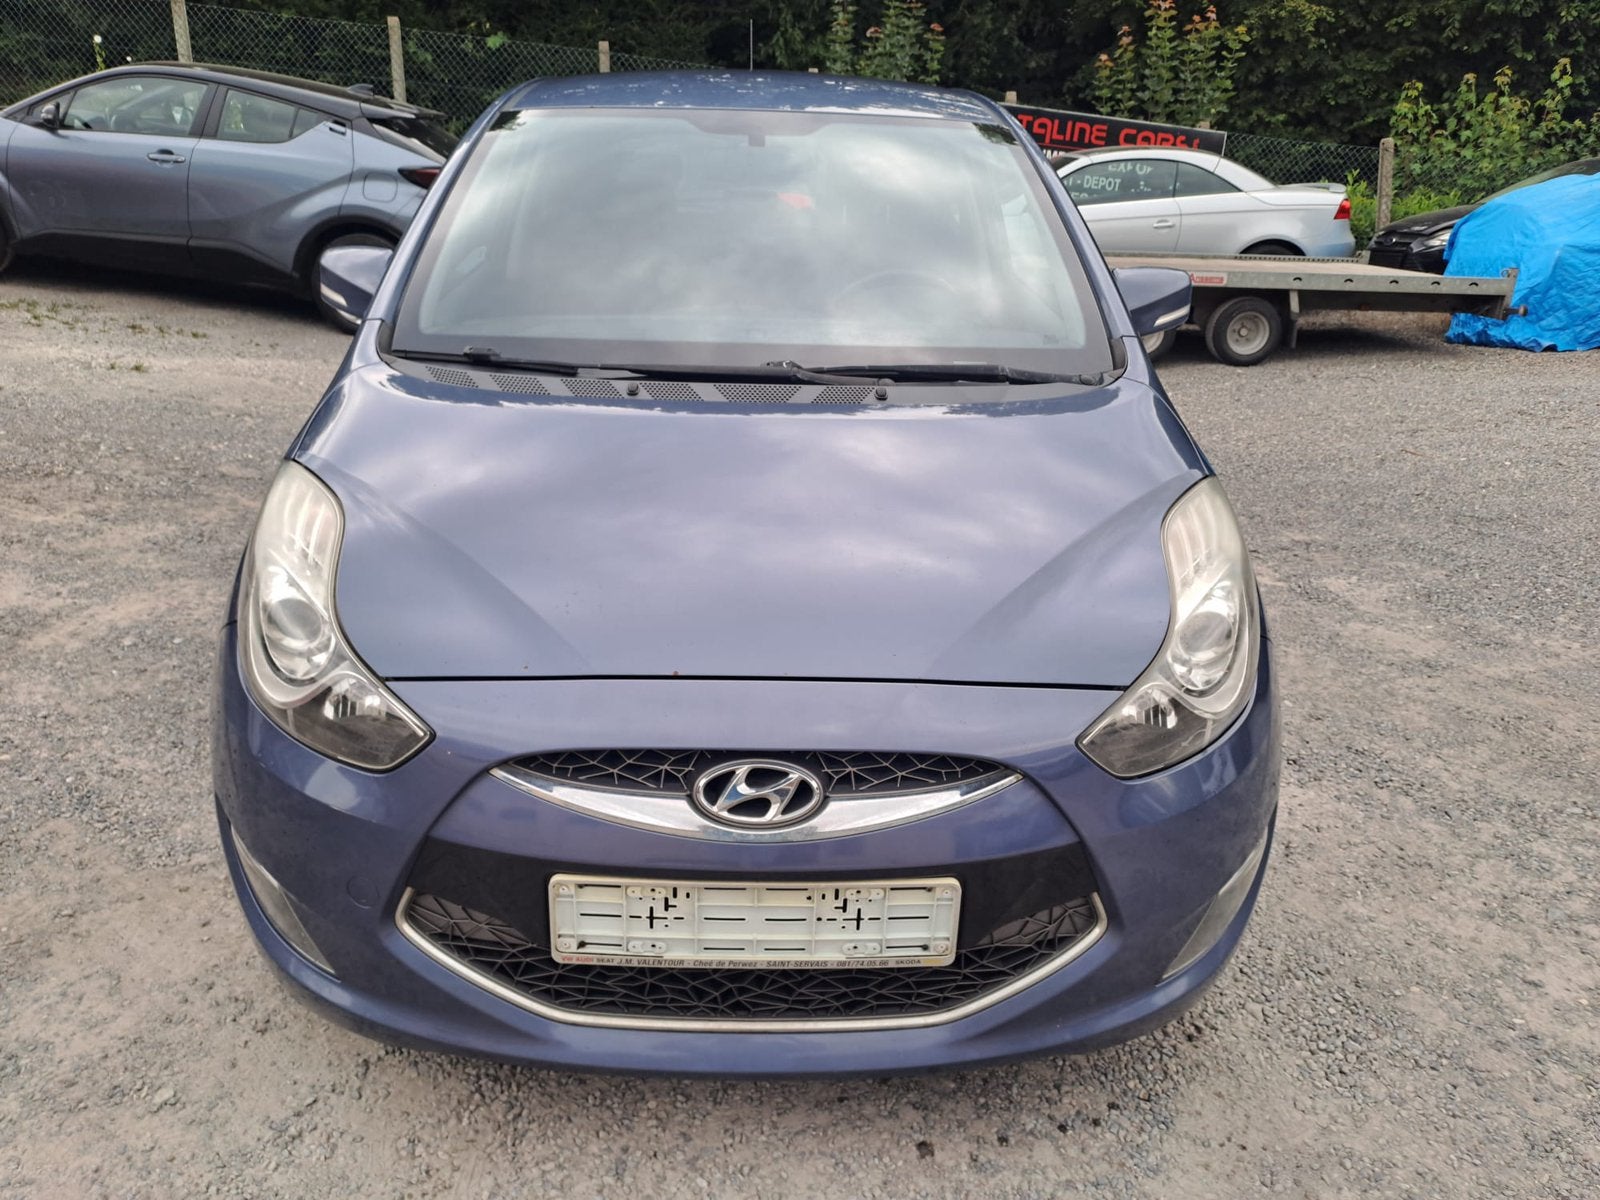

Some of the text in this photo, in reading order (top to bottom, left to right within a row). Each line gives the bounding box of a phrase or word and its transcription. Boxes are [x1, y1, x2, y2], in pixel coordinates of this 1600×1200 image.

[1083, 175, 1121, 192] DEPOT
[575, 956, 594, 964] AUDI
[617, 958, 635, 966] J.M.
[637, 958, 685, 967] VALENTOUR
[728, 960, 757, 968] Perwez
[766, 960, 828, 968] SAINT-SERVAIS
[895, 958, 921, 966] SKODA
